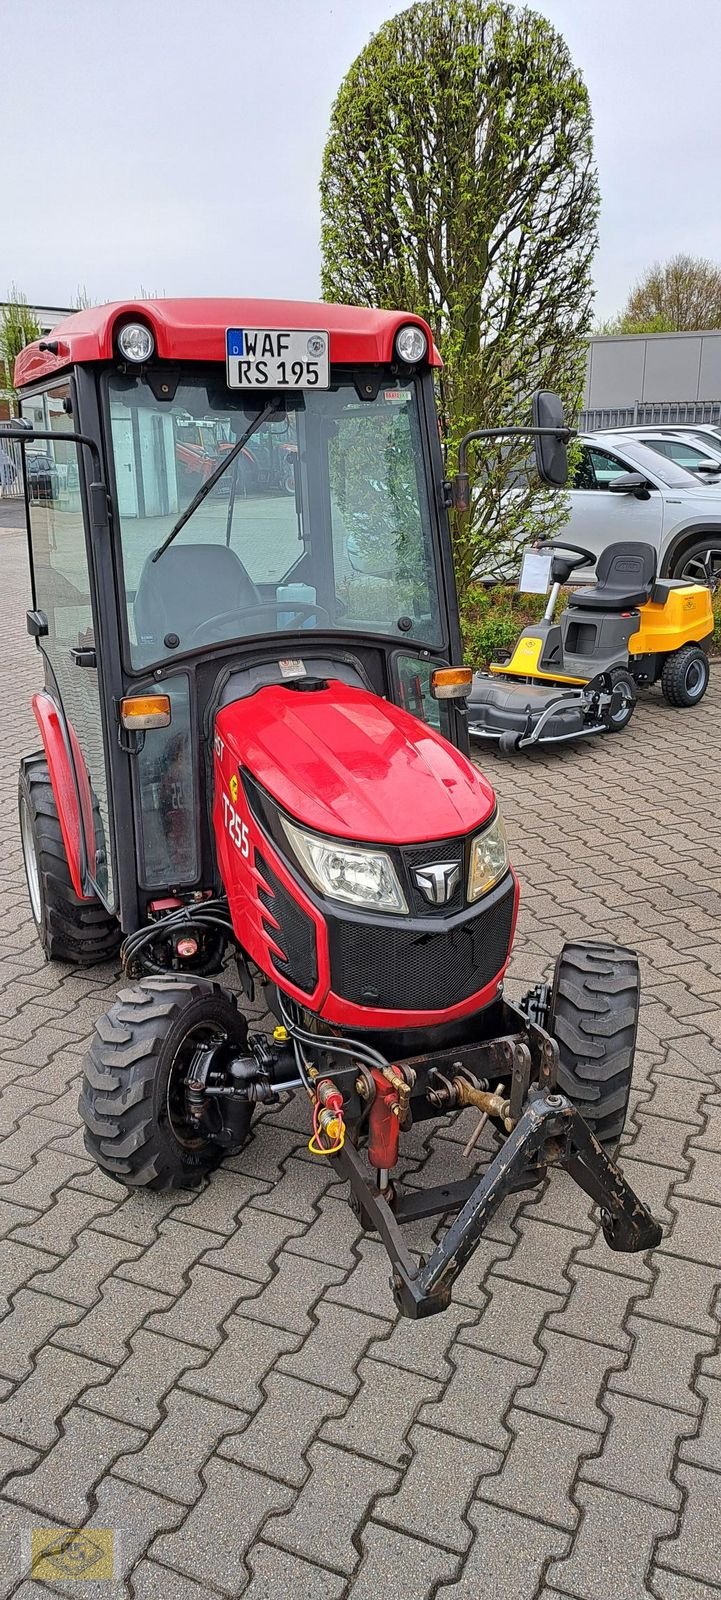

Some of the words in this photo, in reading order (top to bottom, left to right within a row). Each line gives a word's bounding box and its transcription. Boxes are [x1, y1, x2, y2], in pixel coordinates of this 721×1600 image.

[233, 346, 239, 354] D
[244, 333, 291, 357] WAF
[238, 360, 269, 385] RS
[276, 361, 319, 385] 195
[222, 791, 249, 858] T255
